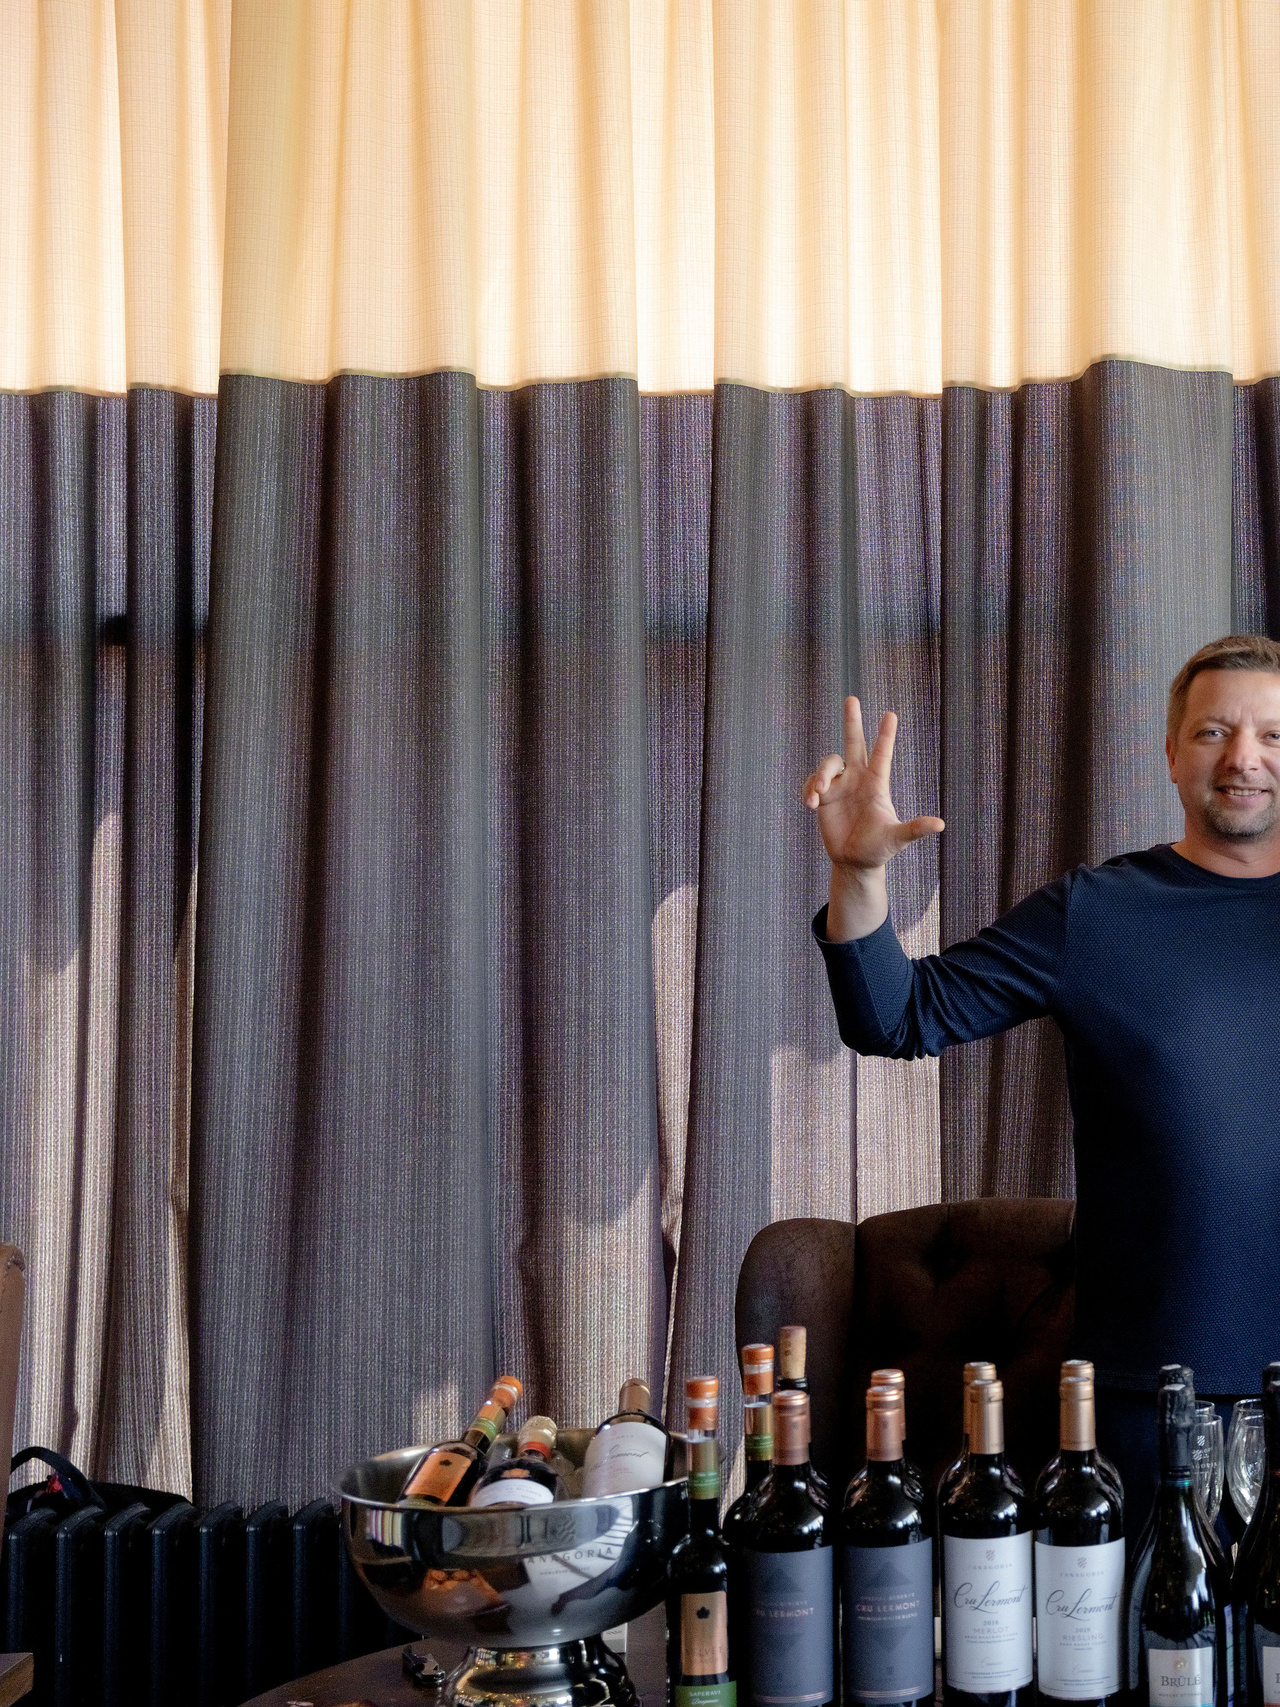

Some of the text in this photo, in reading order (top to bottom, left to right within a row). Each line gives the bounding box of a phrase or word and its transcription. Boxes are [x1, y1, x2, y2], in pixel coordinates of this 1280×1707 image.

[527, 1546, 613, 1565] ANAGORIA
[970, 1580, 1029, 1614] Lermont
[1062, 1587, 1120, 1621] Lermont
[973, 1626, 1010, 1635] MERLOT
[1062, 1633, 1104, 1642] RIESLING
